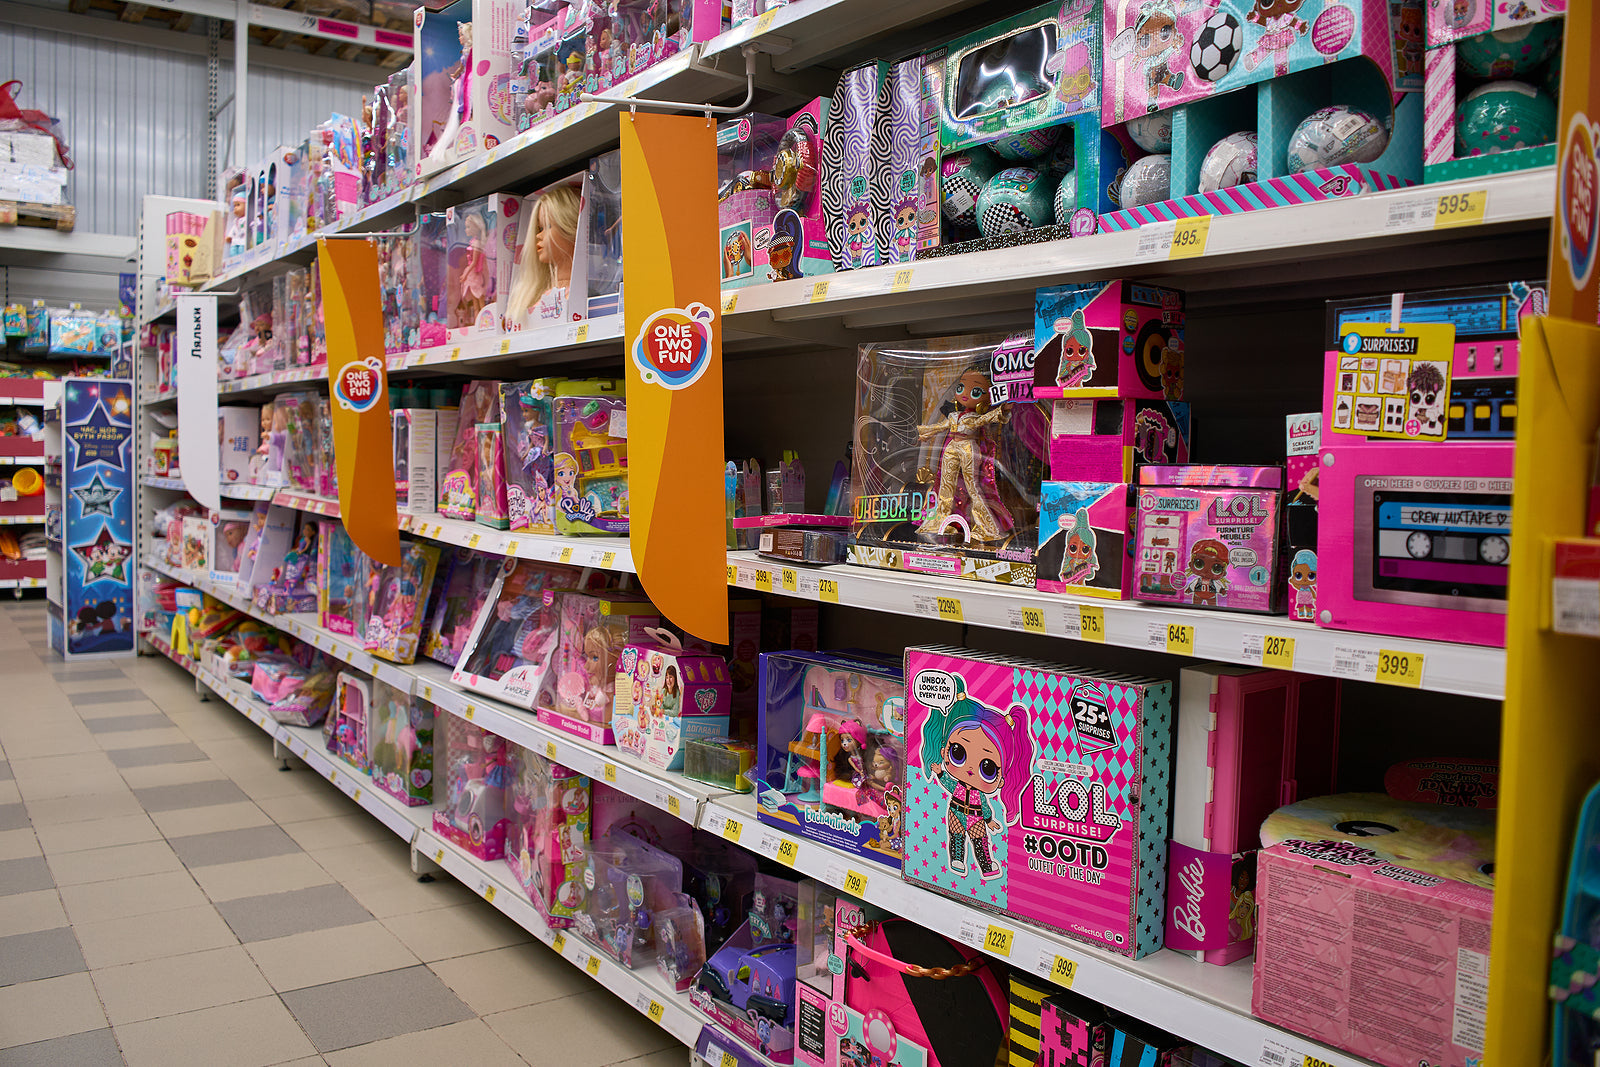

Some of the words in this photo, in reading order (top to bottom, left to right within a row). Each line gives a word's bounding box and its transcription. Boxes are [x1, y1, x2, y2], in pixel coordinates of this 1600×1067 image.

[1058, 25, 1093, 49] DANCE
[1574, 143, 1593, 190] ONE
[1336, 180, 1344, 192] 3
[1572, 168, 1592, 209] TWO
[1439, 194, 1470, 215] 595
[1076, 220, 1090, 233] 12
[1572, 197, 1591, 243] FUN
[1174, 229, 1197, 246] 495
[191, 307, 201, 359] Ляльки
[655, 324, 692, 338] ONE
[655, 338, 692, 350] TWO
[1347, 335, 1358, 351] 9
[1362, 338, 1415, 353] SURPRISES!
[658, 350, 692, 364] FUN
[346, 370, 370, 380] ONE
[347, 379, 370, 387] TWO
[349, 387, 371, 396] FUN
[1364, 479, 1388, 488] OPEN
[1391, 479, 1413, 488] HERE
[1424, 480, 1460, 489] OUVREZ
[1464, 480, 1478, 490] ICI
[562, 498, 595, 522] Polly
[1158, 499, 1199, 510] SURPRISES!
[1411, 510, 1440, 523] CREW
[1443, 510, 1493, 525] MIXTAPE
[1220, 533, 1251, 541] MEUBLES
[756, 569, 767, 582] 399
[783, 569, 793, 583] 199
[820, 579, 832, 593] 273
[939, 598, 956, 614] 2299
[1025, 610, 1039, 626] 399
[1082, 615, 1097, 631] 575
[1169, 625, 1185, 643] 645
[1266, 637, 1285, 657] 287
[1380, 654, 1409, 677] 399
[921, 676, 946, 684] UNBOX
[919, 691, 936, 699] EVERY
[1075, 701, 1108, 725] 25+
[561, 719, 577, 731] Fashion
[1078, 722, 1111, 739] SURPRISES
[726, 818, 738, 833] 379
[805, 805, 861, 836] Enchantimals
[1033, 816, 1101, 837] SURPRISE!
[780, 841, 791, 857] 458
[1024, 834, 1108, 869] #OOTD
[1028, 857, 1054, 874] OUTFIT
[1057, 863, 1067, 877] OF
[1069, 866, 1084, 882] THE
[1086, 870, 1101, 885] DAY
[847, 874, 861, 892] 799
[1173, 857, 1206, 942] Barbie
[988, 929, 1006, 948] 1228
[1071, 923, 1103, 939] #CollectLOL
[1056, 958, 1072, 977] 999
[831, 1005, 844, 1025] 50
